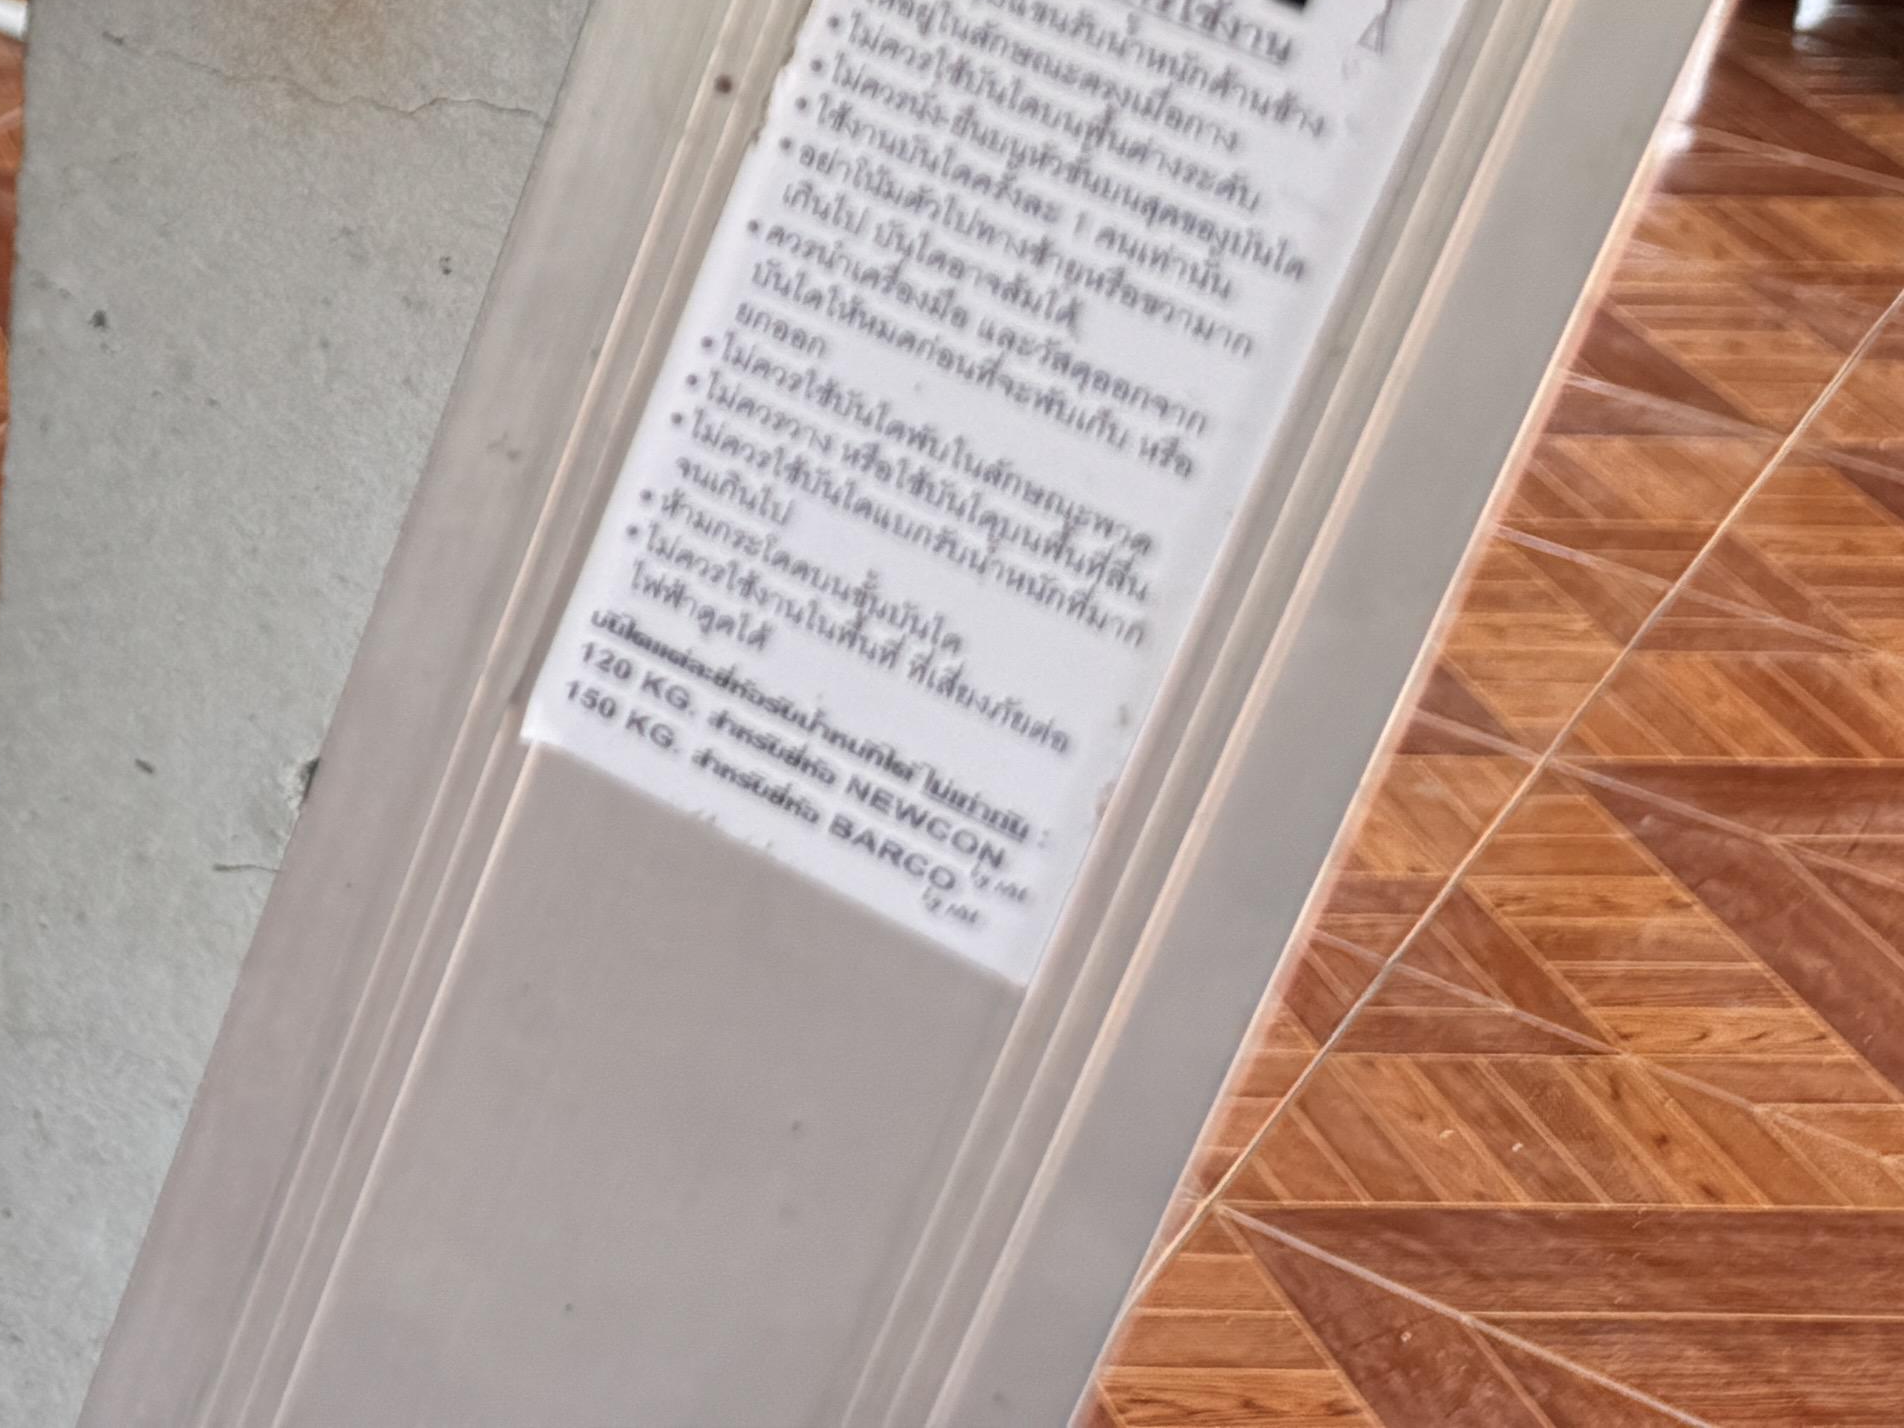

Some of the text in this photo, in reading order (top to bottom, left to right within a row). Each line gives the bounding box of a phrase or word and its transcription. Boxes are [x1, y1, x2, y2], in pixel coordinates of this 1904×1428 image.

[567, 680, 618, 720] 150
[624, 709, 690, 757] KG.
[828, 813, 956, 891] BARCO
[582, 641, 634, 682] 120
[639, 670, 706, 719] KG.
[845, 775, 1005, 869] NEWCON
